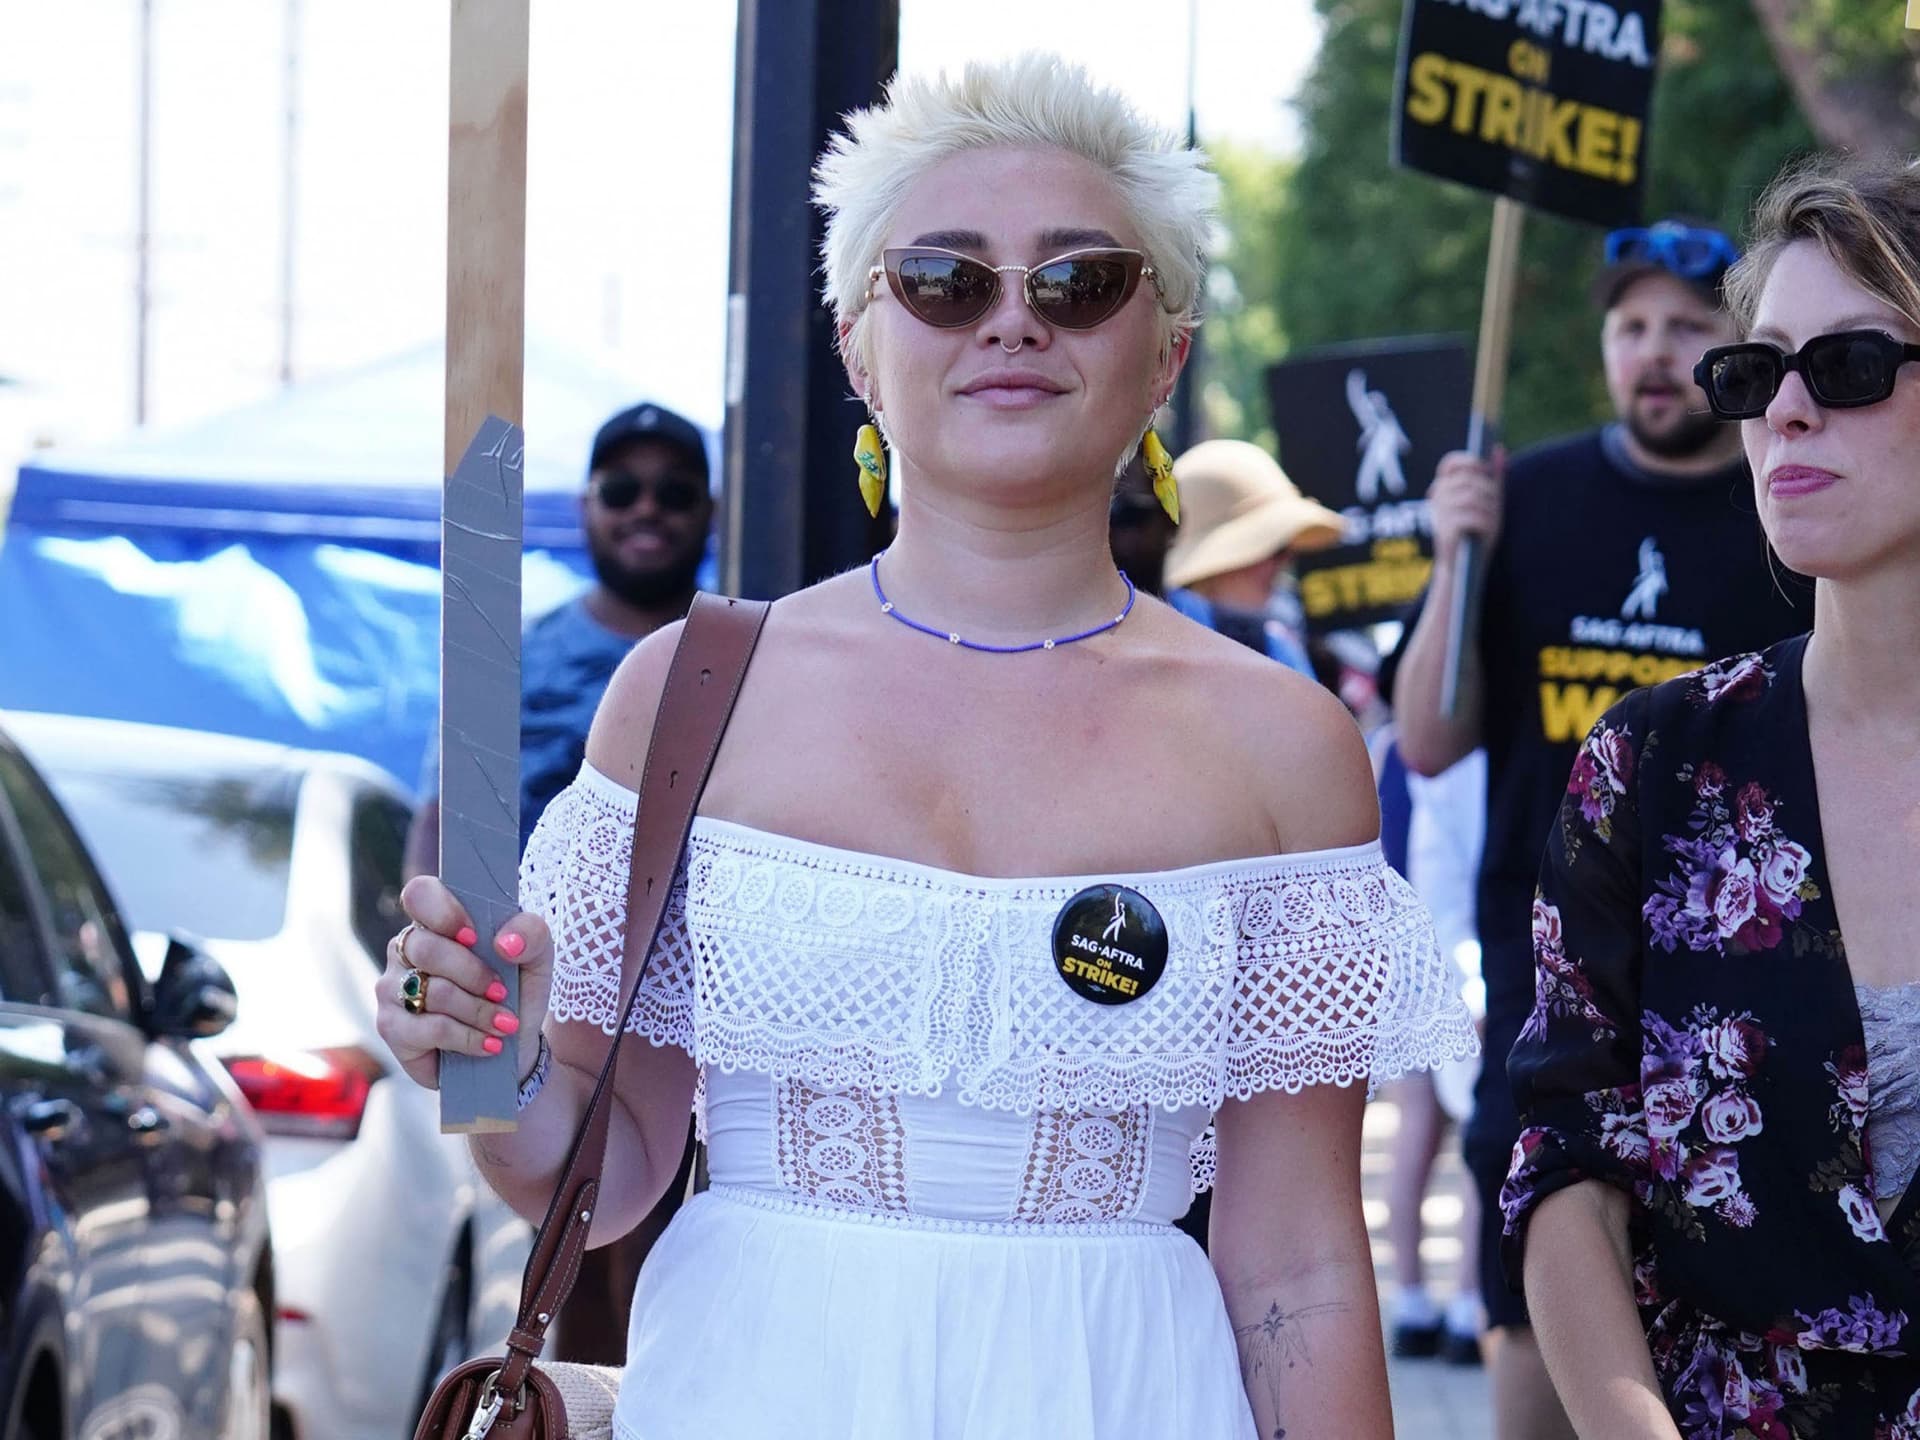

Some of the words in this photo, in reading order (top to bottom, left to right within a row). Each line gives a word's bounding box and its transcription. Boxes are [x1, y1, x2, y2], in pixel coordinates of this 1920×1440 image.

[1407, 52, 1642, 184] STRIKE!
[1062, 957, 1139, 994] STRIKE!
[1096, 958, 1112, 969] ON
